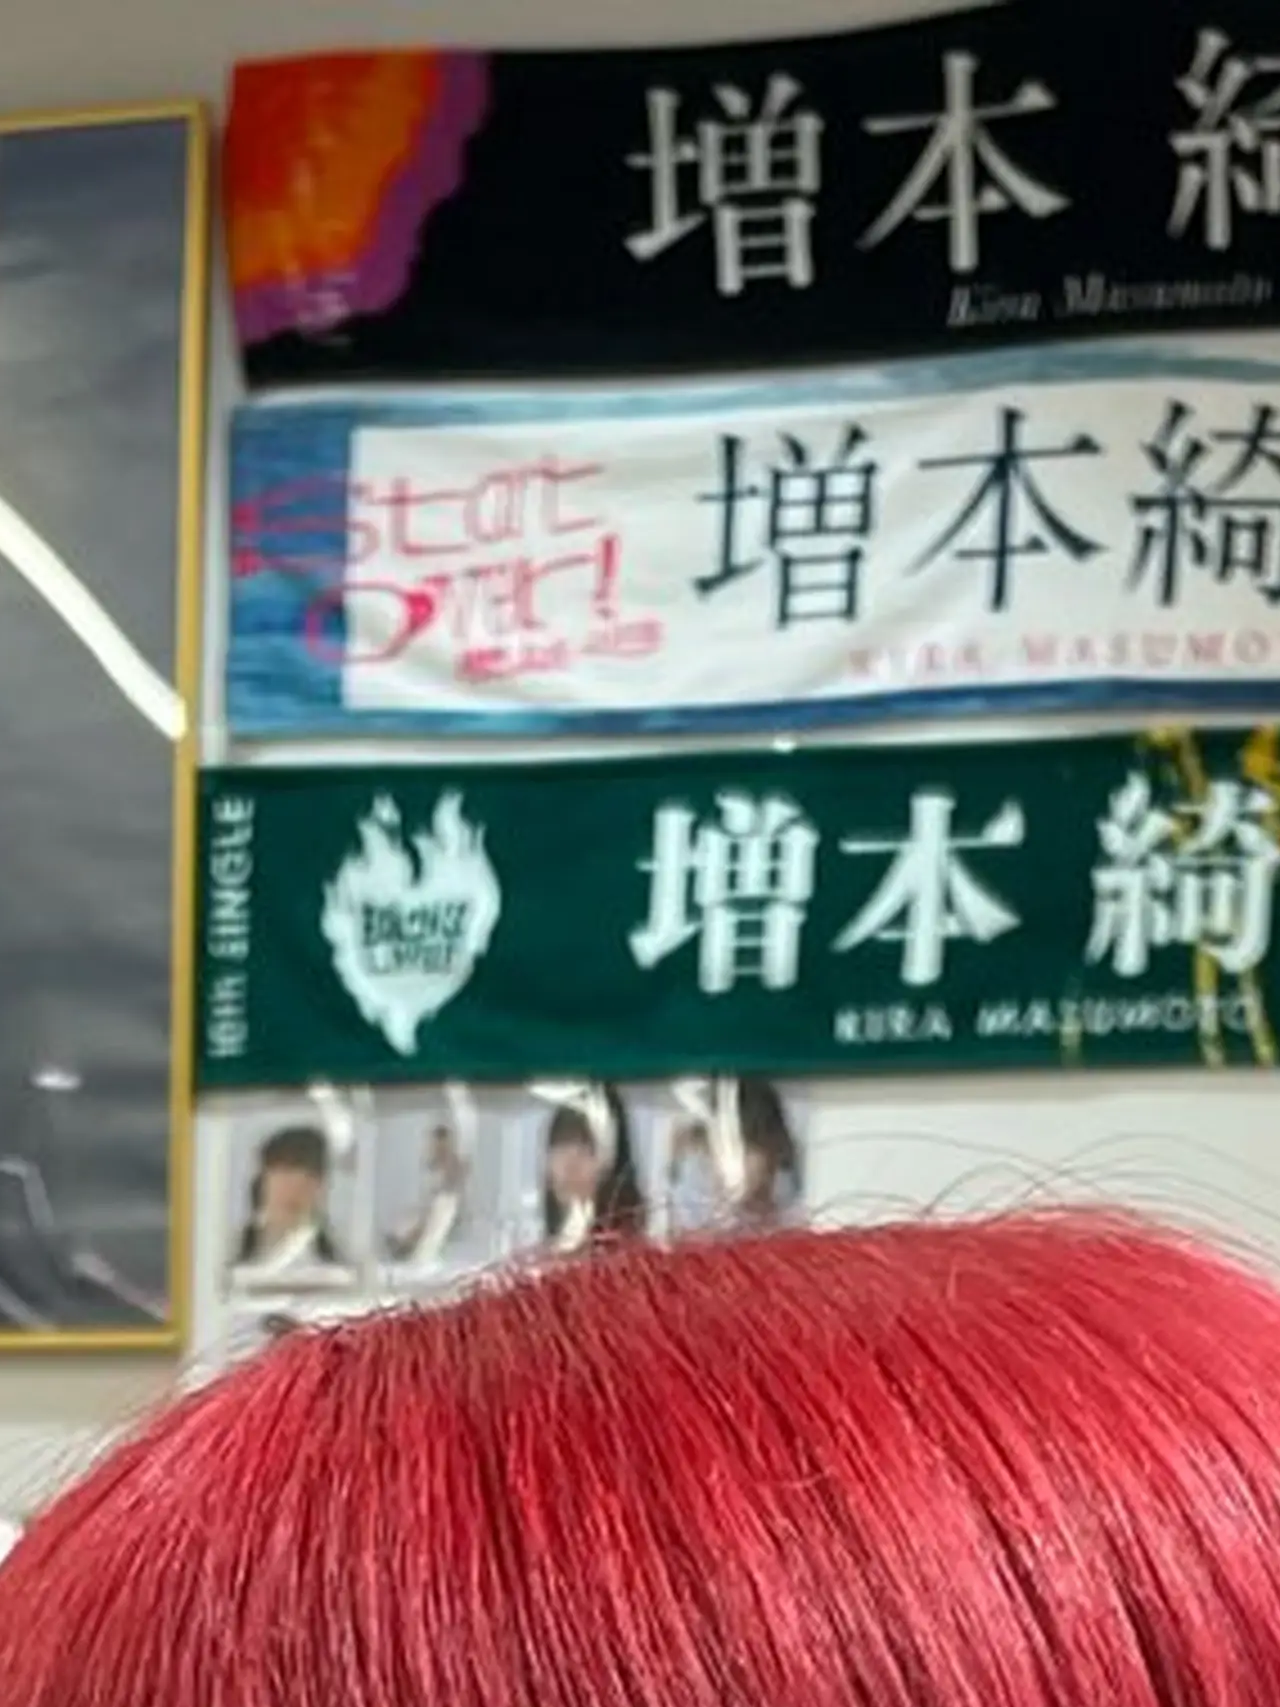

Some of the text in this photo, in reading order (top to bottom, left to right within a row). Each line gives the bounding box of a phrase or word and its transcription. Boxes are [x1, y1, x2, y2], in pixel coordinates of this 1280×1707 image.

[624, 50, 1072, 297] 増本
[206, 794, 256, 960] SINGLE
[628, 790, 1023, 994] 増本
